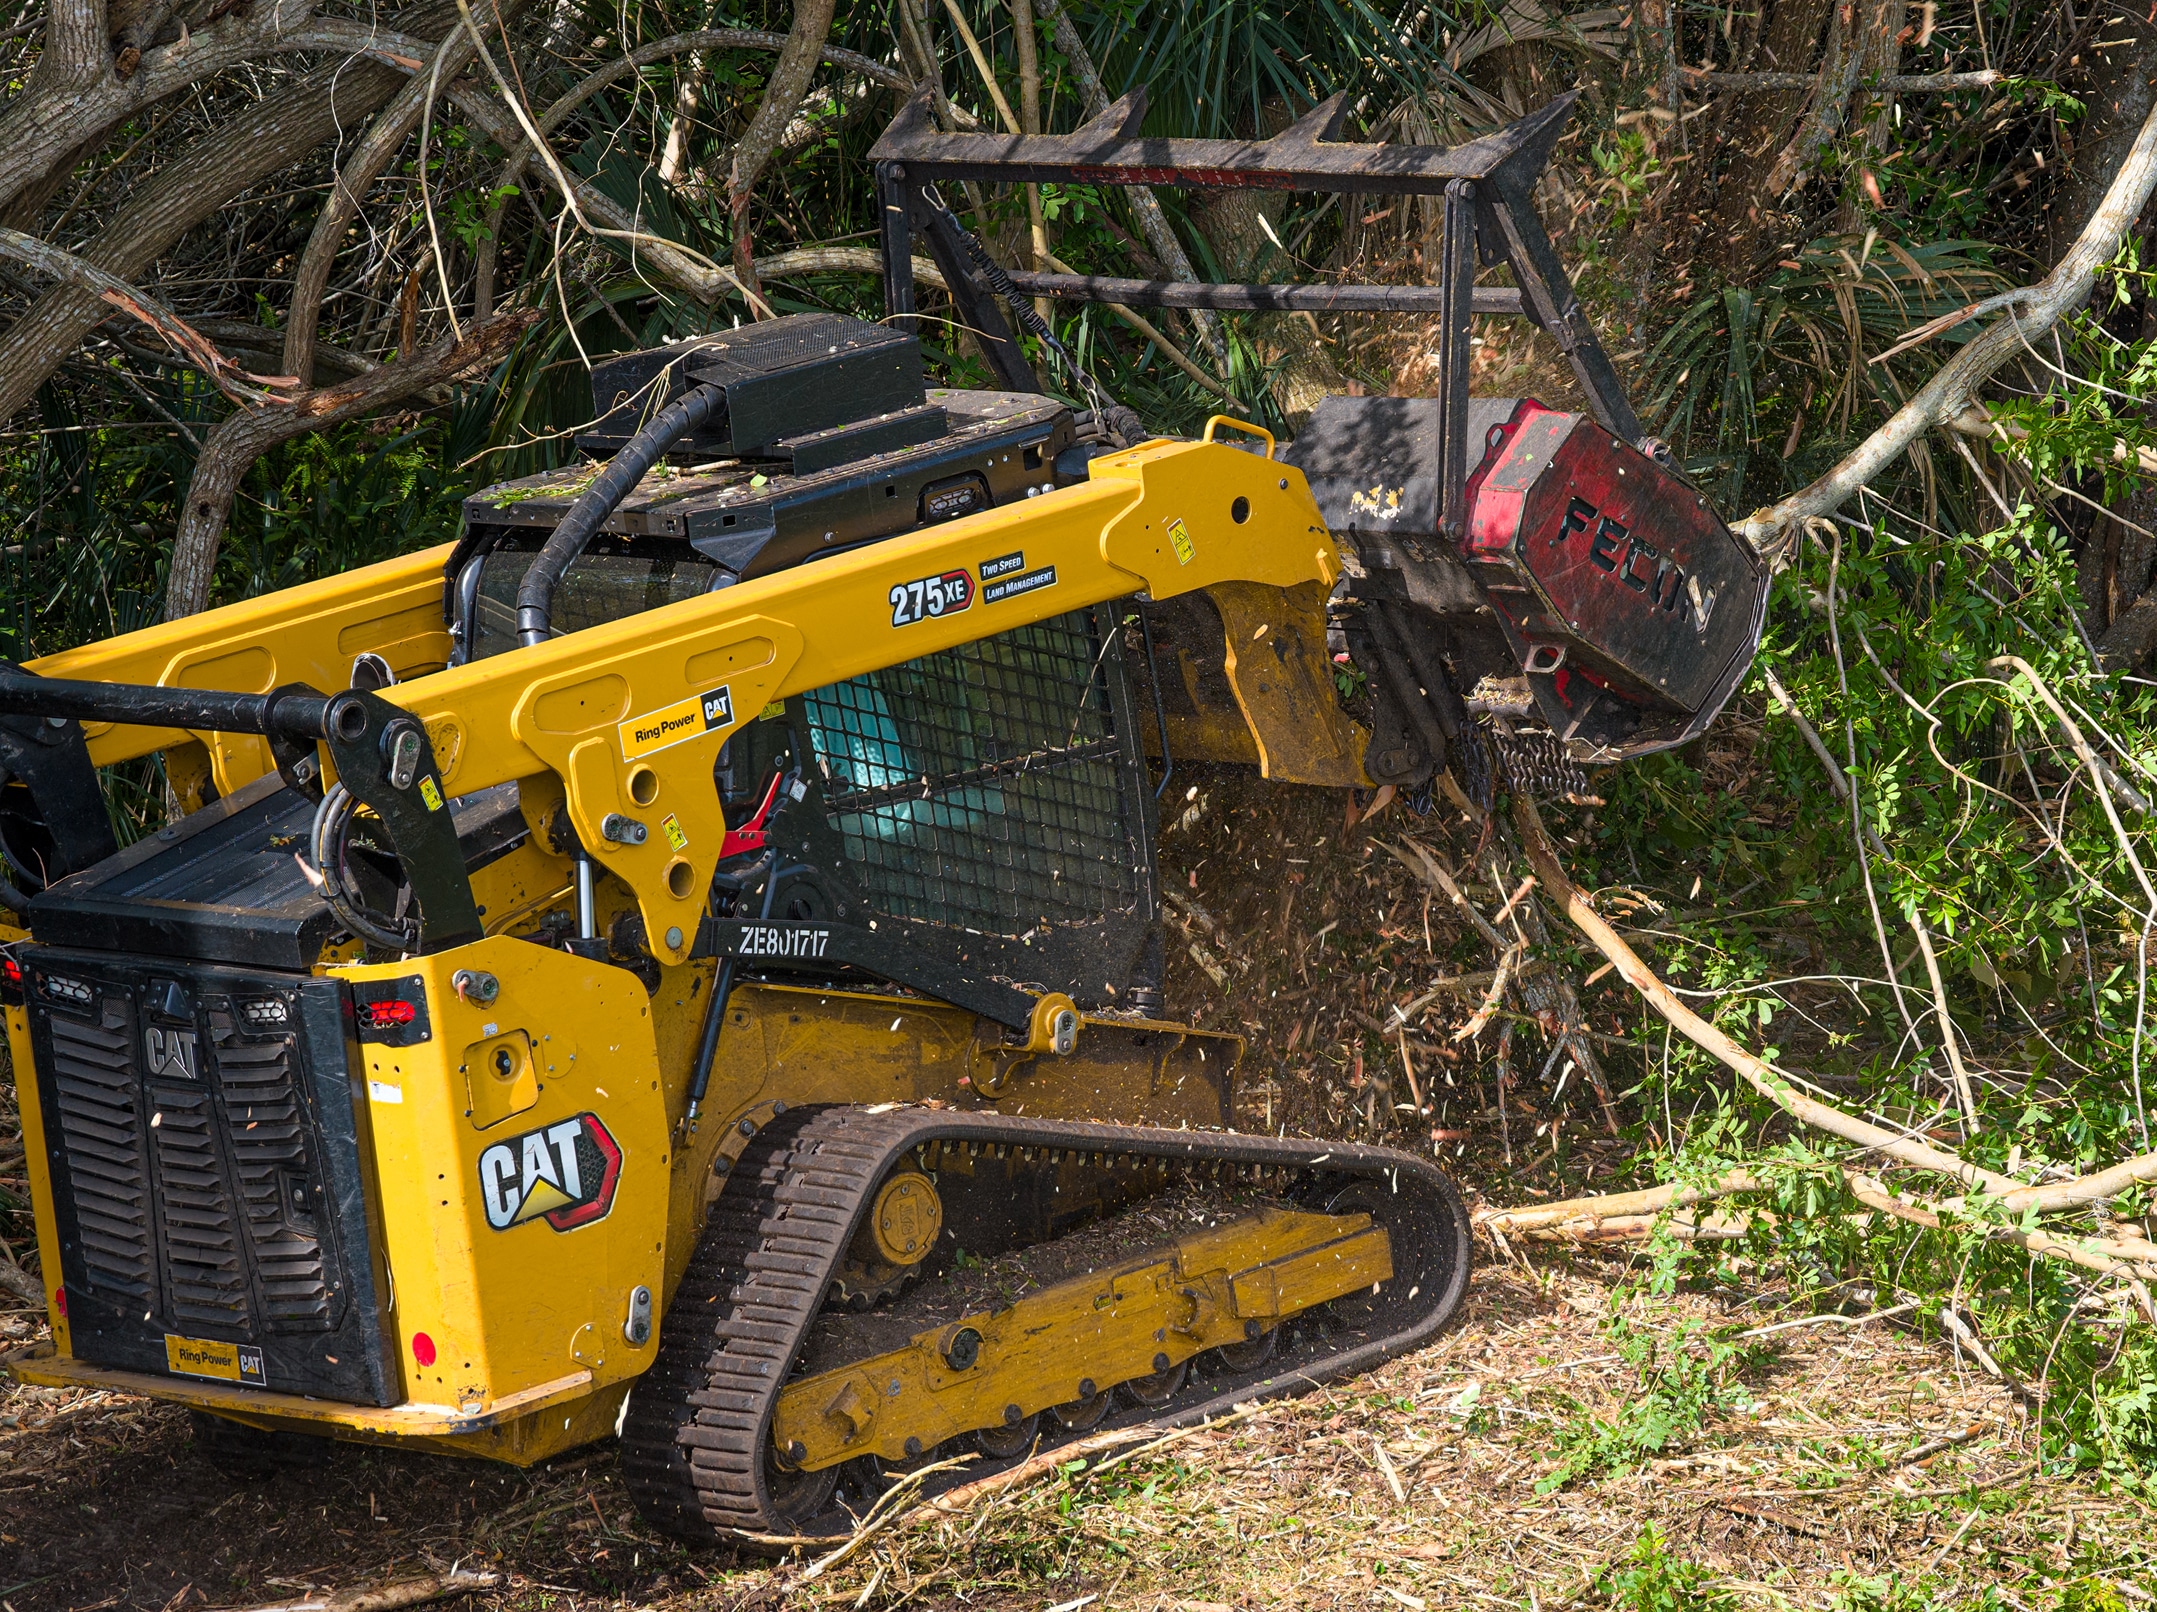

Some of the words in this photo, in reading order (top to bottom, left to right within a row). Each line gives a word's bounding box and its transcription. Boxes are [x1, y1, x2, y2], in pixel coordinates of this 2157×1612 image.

[635, 728, 660, 743] Ring
[661, 713, 696, 734] Power
[704, 696, 728, 720] CAT
[739, 926, 829, 957] ZE801717
[145, 1027, 197, 1079] CAT
[481, 1118, 582, 1228] CAT
[179, 1348, 201, 1365] Ring
[202, 1351, 232, 1367] Power
[240, 1354, 260, 1375] CAT
